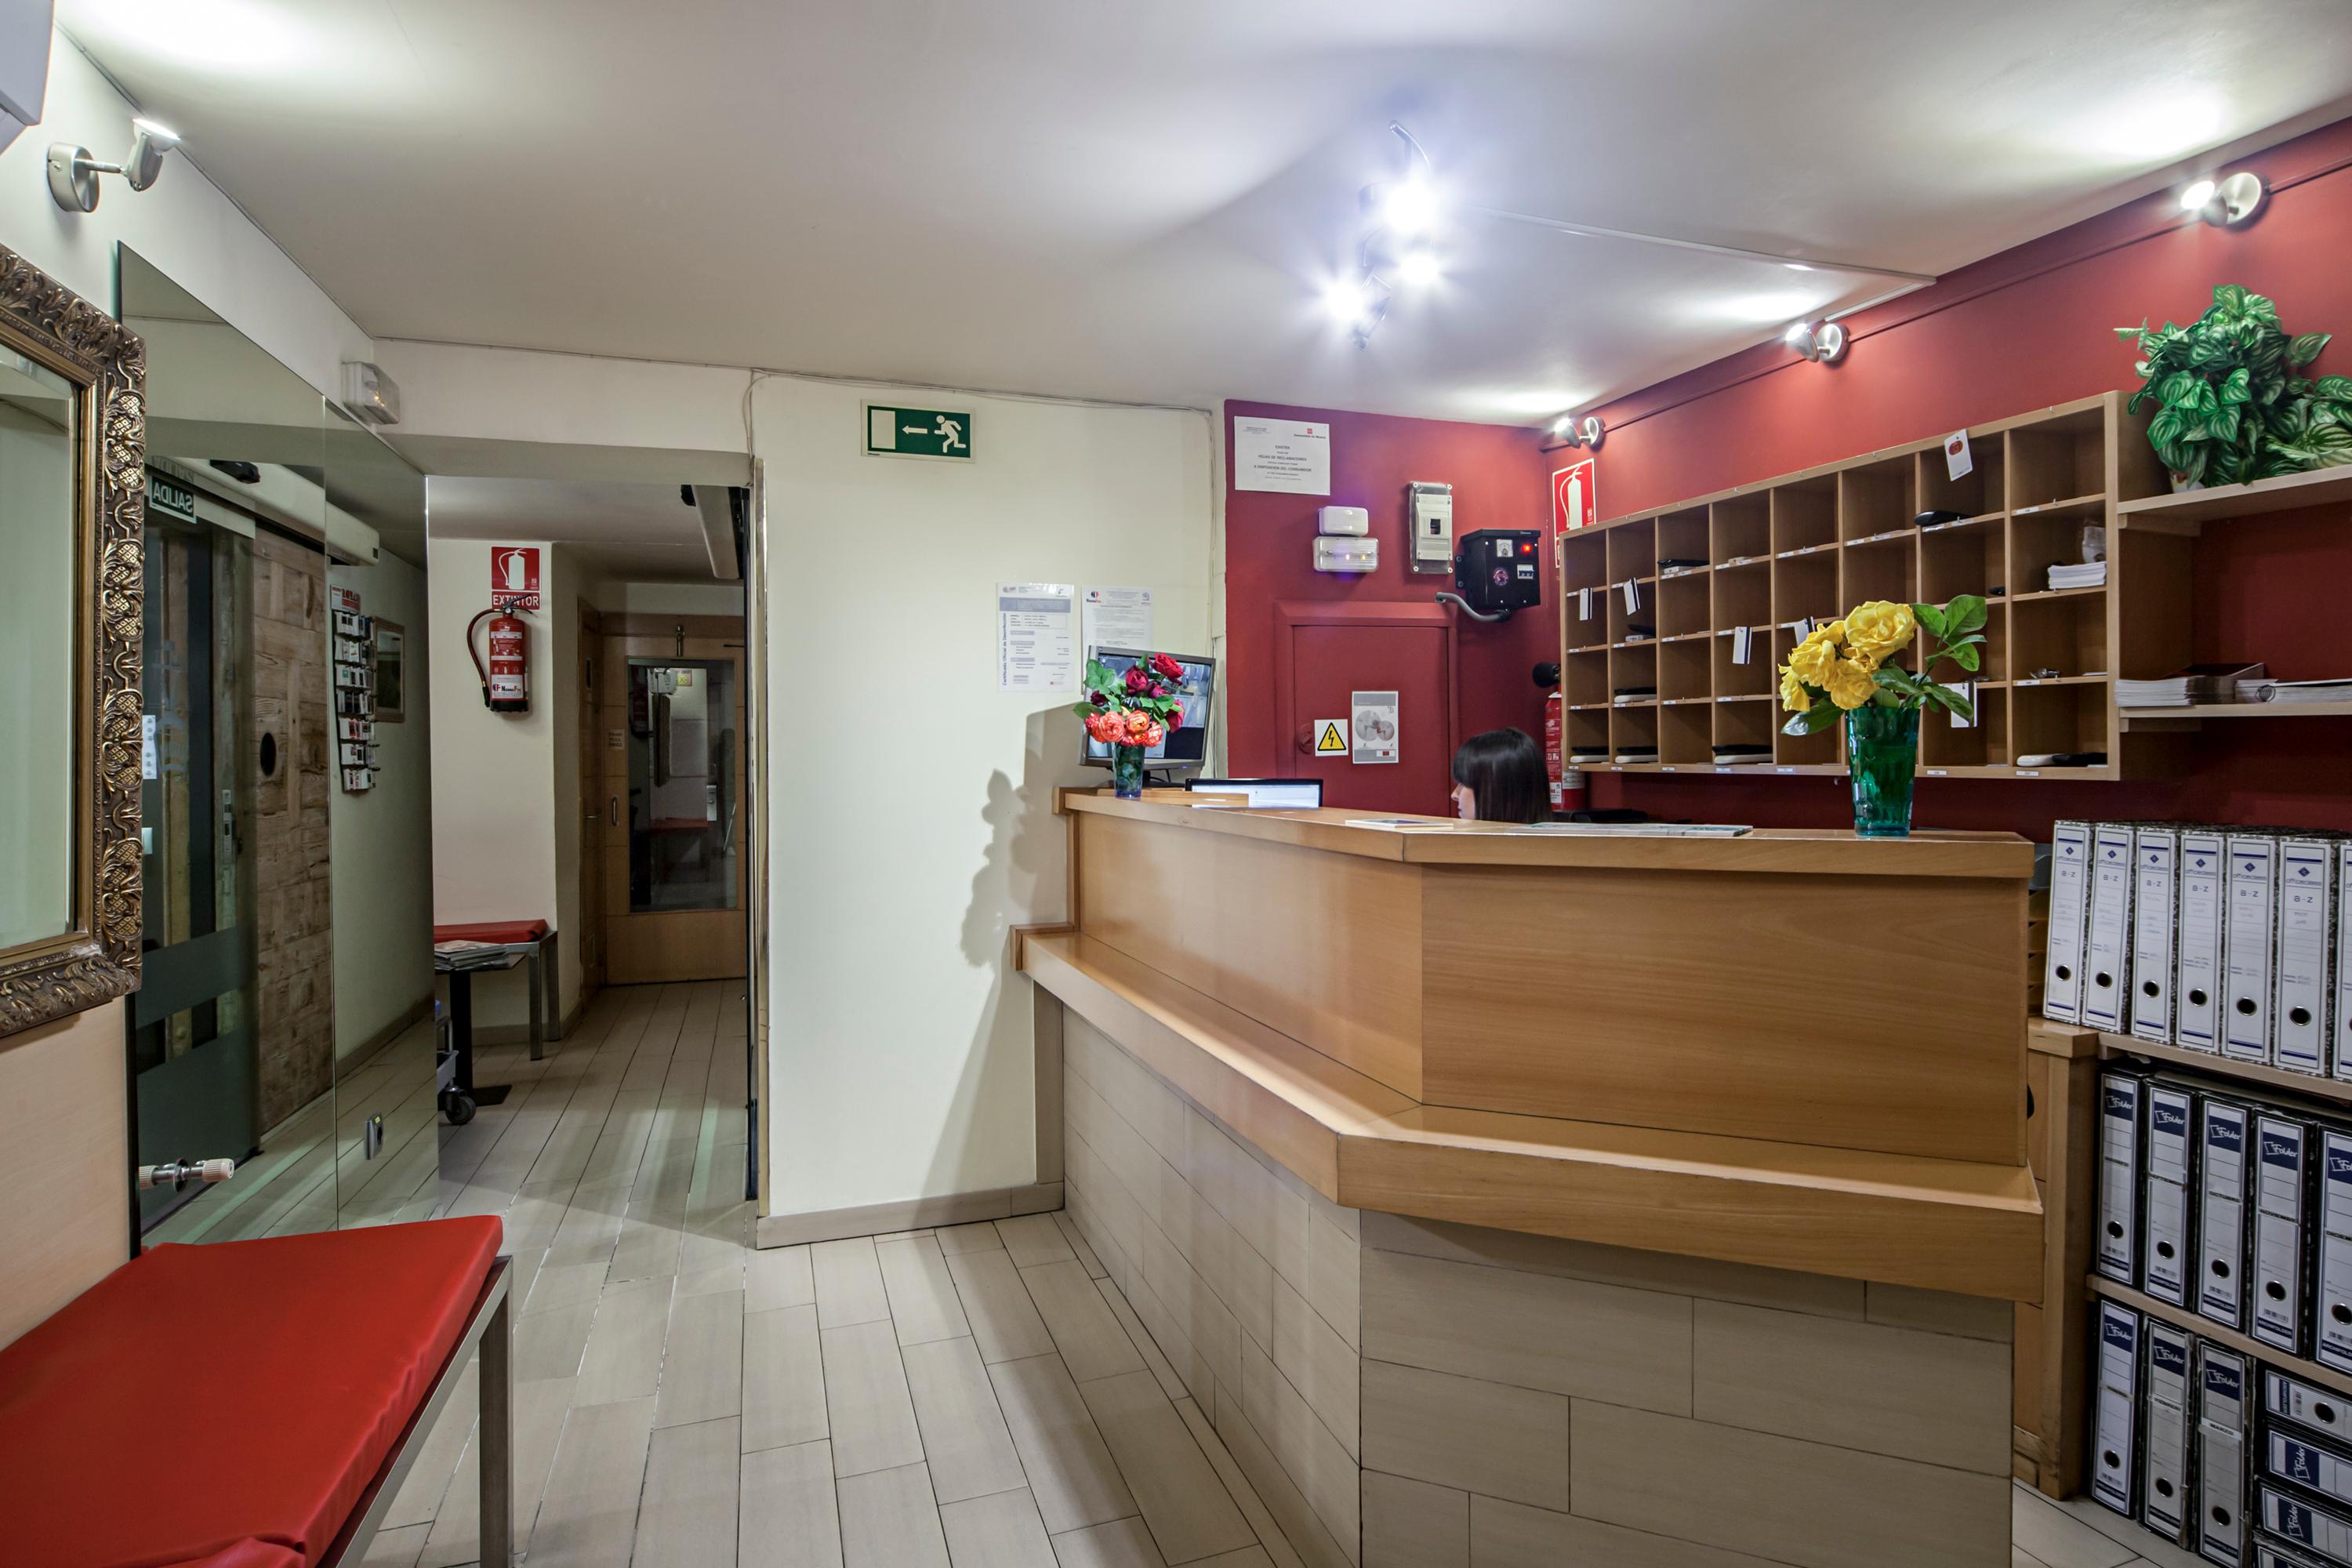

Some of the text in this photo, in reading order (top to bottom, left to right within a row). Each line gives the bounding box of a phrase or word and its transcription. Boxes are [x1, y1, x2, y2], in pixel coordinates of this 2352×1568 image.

[2111, 1098, 2133, 1109] Folder
[2161, 1112, 2185, 1125] Folder
[2216, 1127, 2241, 1140] Folder
[2271, 1143, 2298, 1158] Folder
[2209, 1190, 2241, 1203] OCTUBRE
[2111, 1326, 2133, 1341] Folder
[2161, 1349, 2184, 1364] Folder
[2213, 1372, 2240, 1388] Folder
[2209, 1422, 2234, 1436] MARZO
[2294, 1446, 2307, 1471] Folder
